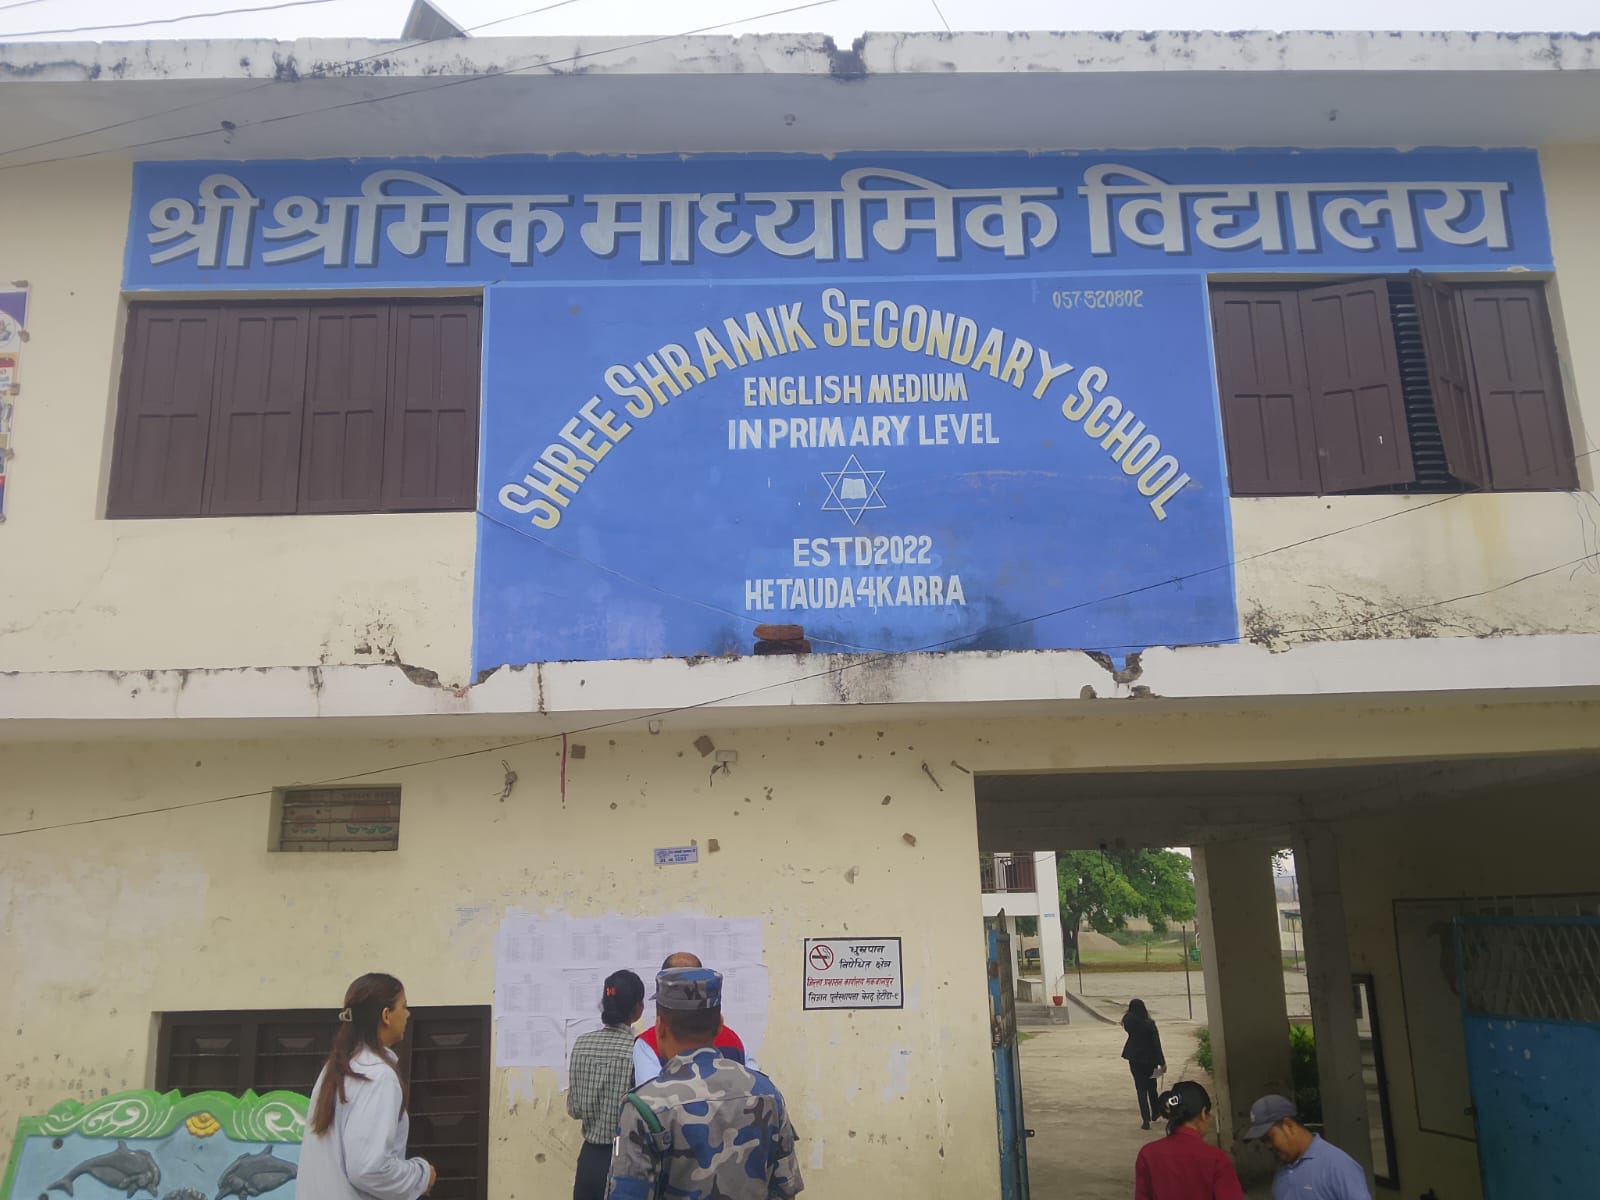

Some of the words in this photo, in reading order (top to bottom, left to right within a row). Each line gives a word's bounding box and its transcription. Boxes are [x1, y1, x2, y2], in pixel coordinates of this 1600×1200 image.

[147, 173, 260, 268] श्री
[262, 169, 573, 267] श्रमिक
[580, 166, 1059, 262] माध्यमिक
[1078, 164, 1510, 255] विद्यालय
[498, 395, 633, 530] SHREE
[604, 301, 817, 420] SHRAMIK
[821, 287, 1074, 401] SECONDARY
[1061, 365, 1192, 521] SCHOOL
[743, 374, 863, 407] ENGLISH
[867, 373, 969, 404] MEDIUM
[728, 418, 763, 450] IN
[768, 415, 911, 449] PRIMARY
[918, 412, 1000, 446] LEVEL
[876, 574, 967, 608] KARRA
